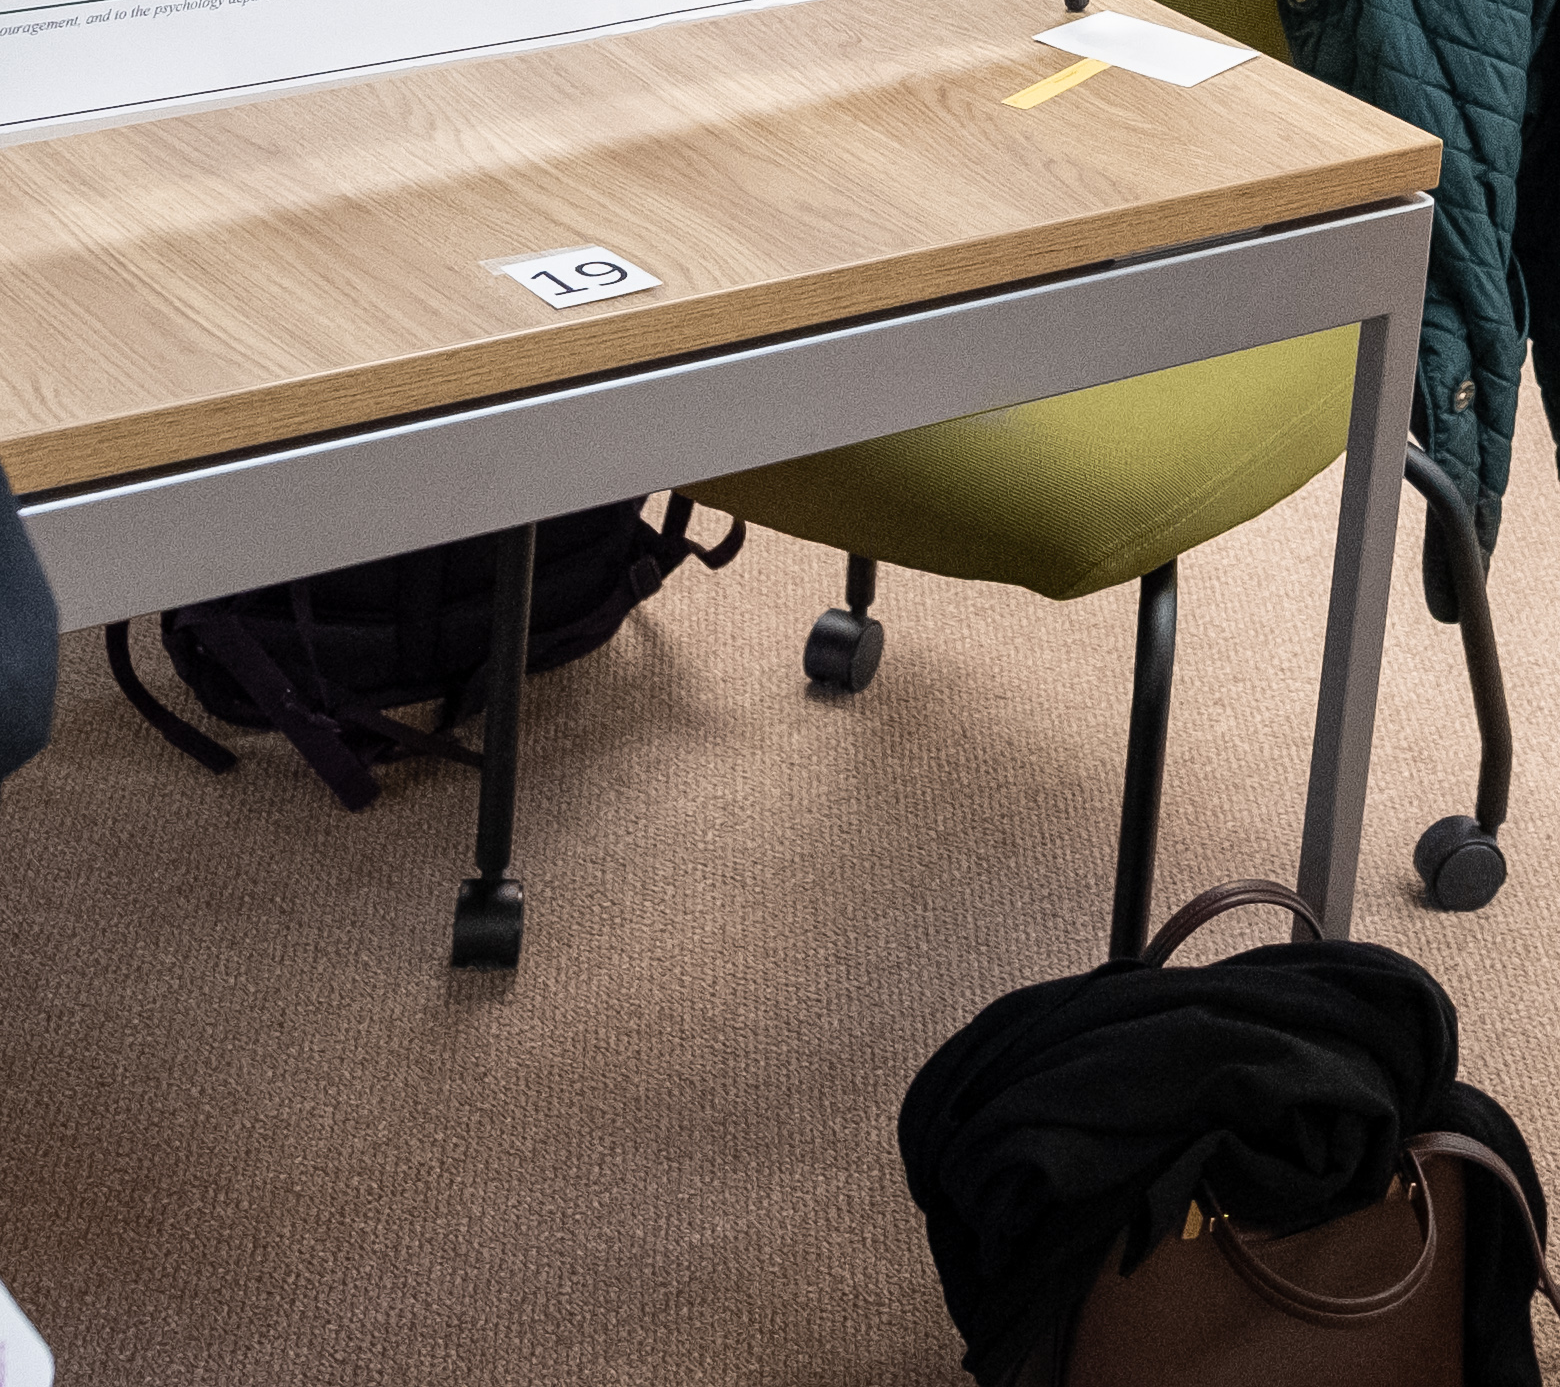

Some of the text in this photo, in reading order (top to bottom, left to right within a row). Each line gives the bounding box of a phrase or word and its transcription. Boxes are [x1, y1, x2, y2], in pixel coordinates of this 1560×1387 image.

[85, 8, 113, 25] and
[130, 4, 152, 18] the
[528, 259, 631, 298] 19
